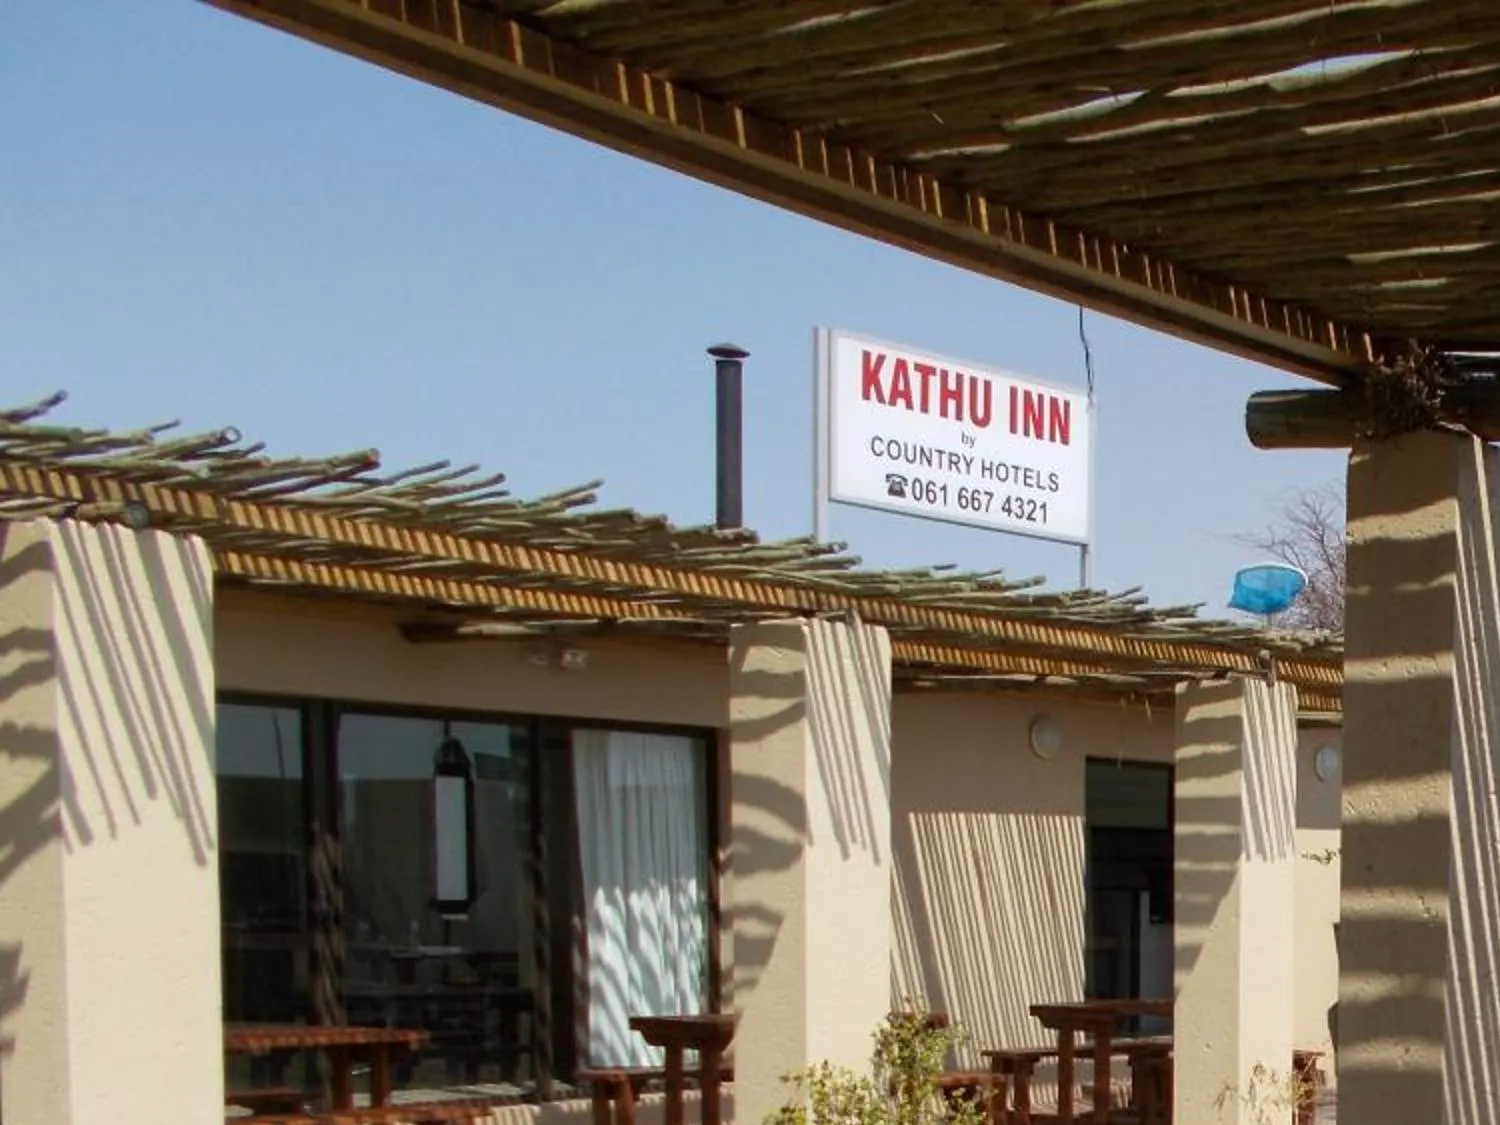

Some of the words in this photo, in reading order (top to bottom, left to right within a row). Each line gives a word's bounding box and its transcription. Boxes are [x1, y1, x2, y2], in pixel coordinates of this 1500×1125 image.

[861, 349, 992, 428] KATHU
[1009, 385, 1070, 446] INN
[871, 435, 974, 475] COUNTRY
[981, 459, 1060, 492] HOTELS
[961, 431, 976, 448] by
[911, 477, 947, 506] 061
[957, 487, 994, 513] 667
[1001, 495, 1048, 524] 4321
